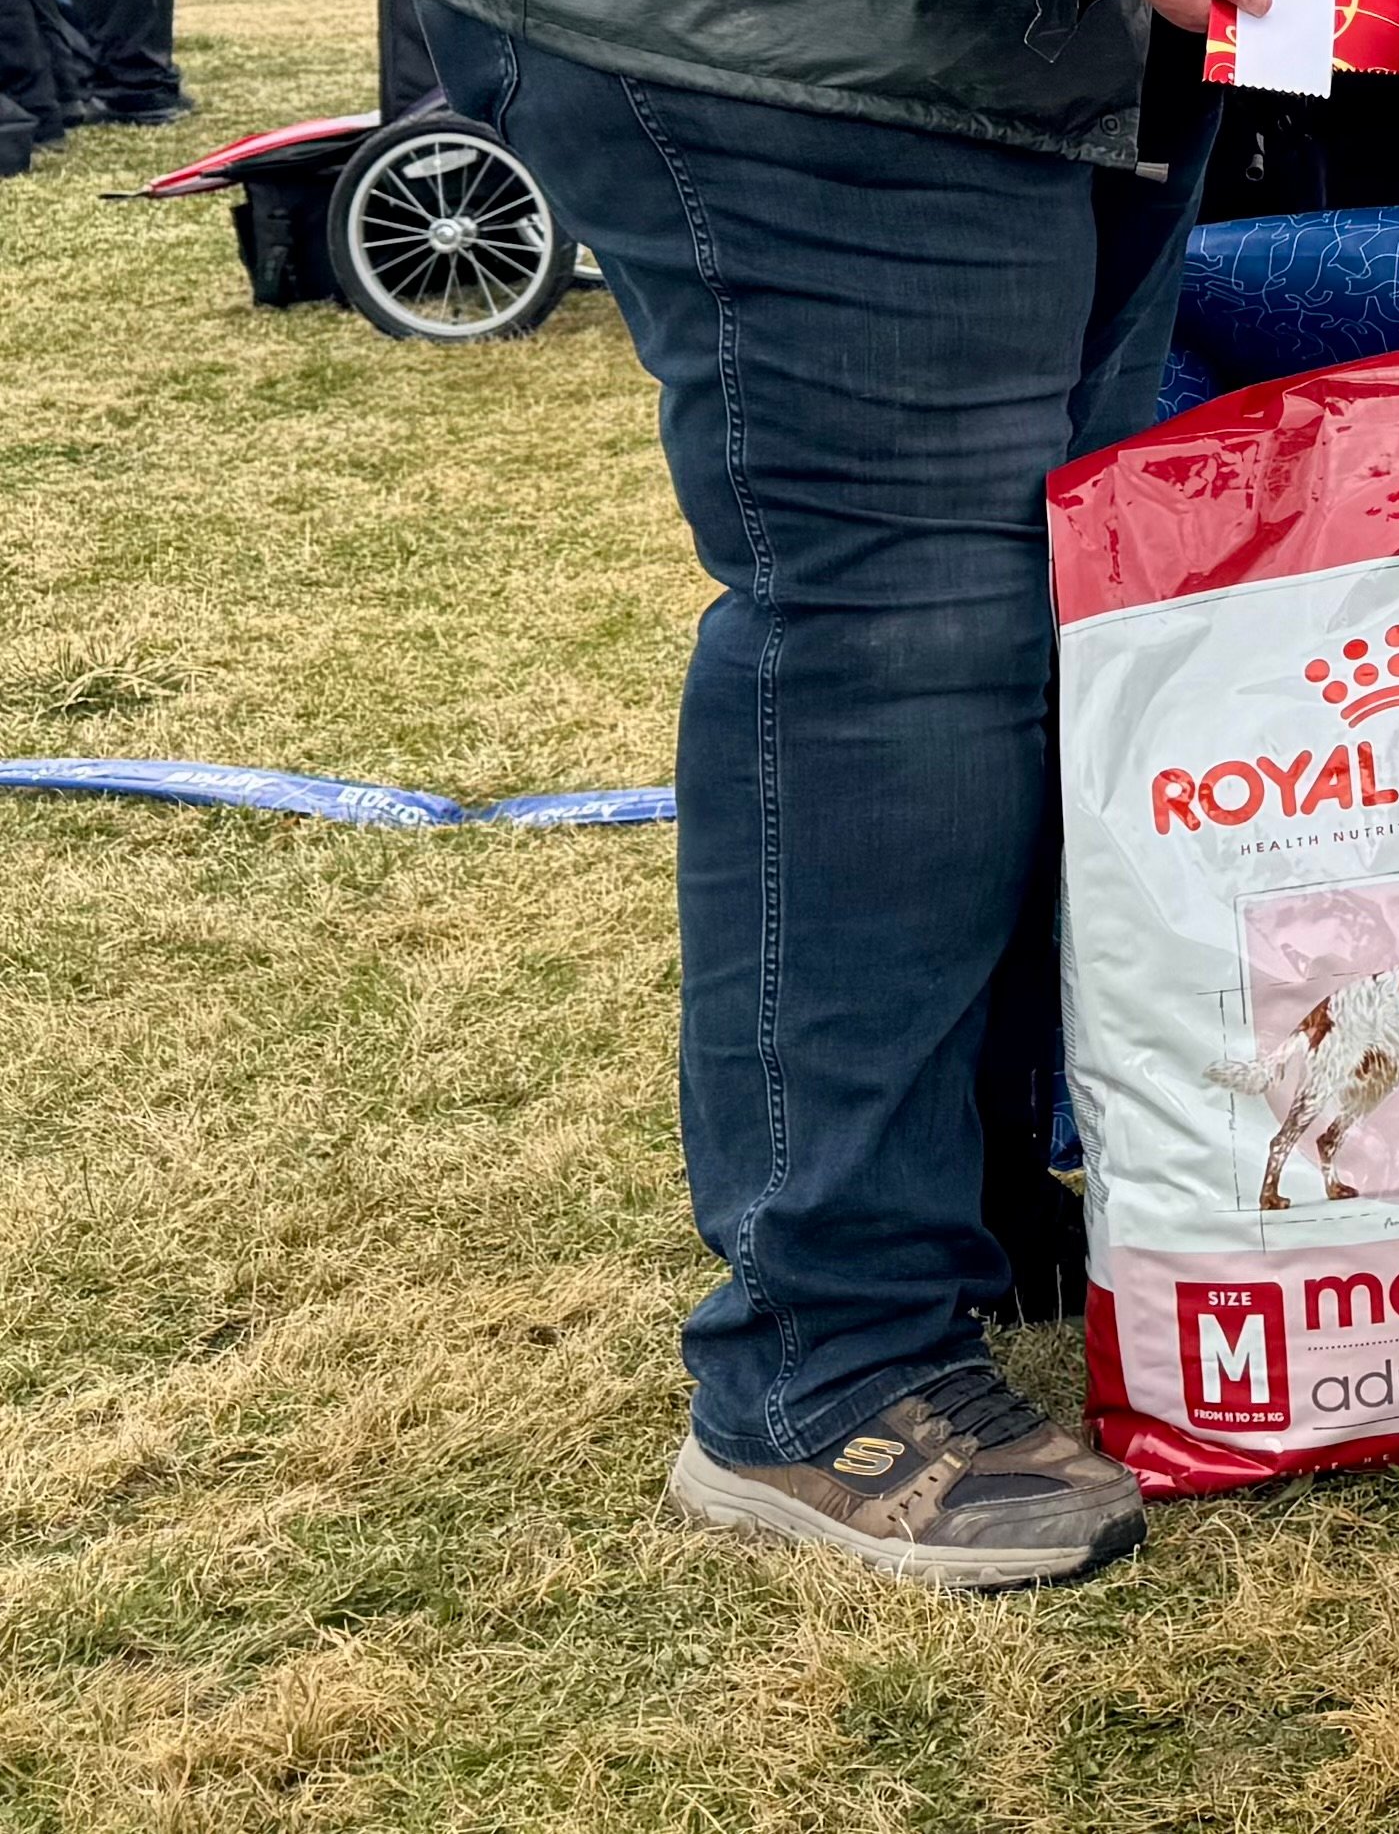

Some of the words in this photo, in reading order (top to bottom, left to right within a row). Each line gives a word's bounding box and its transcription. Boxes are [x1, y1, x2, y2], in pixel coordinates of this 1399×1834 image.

[1150, 740, 1399, 835] ROYAL
[1240, 835, 1319, 856] HEALTH
[1207, 1291, 1253, 1307] SIZE
[1197, 1313, 1270, 1404] M
[1194, 1409, 1223, 1421] FROM
[1225, 1412, 1233, 1422] 11
[1235, 1412, 1250, 1422] TO
[1252, 1412, 1265, 1422] 25
[1267, 1412, 1284, 1422] KG
[833, 1437, 905, 1477] S
